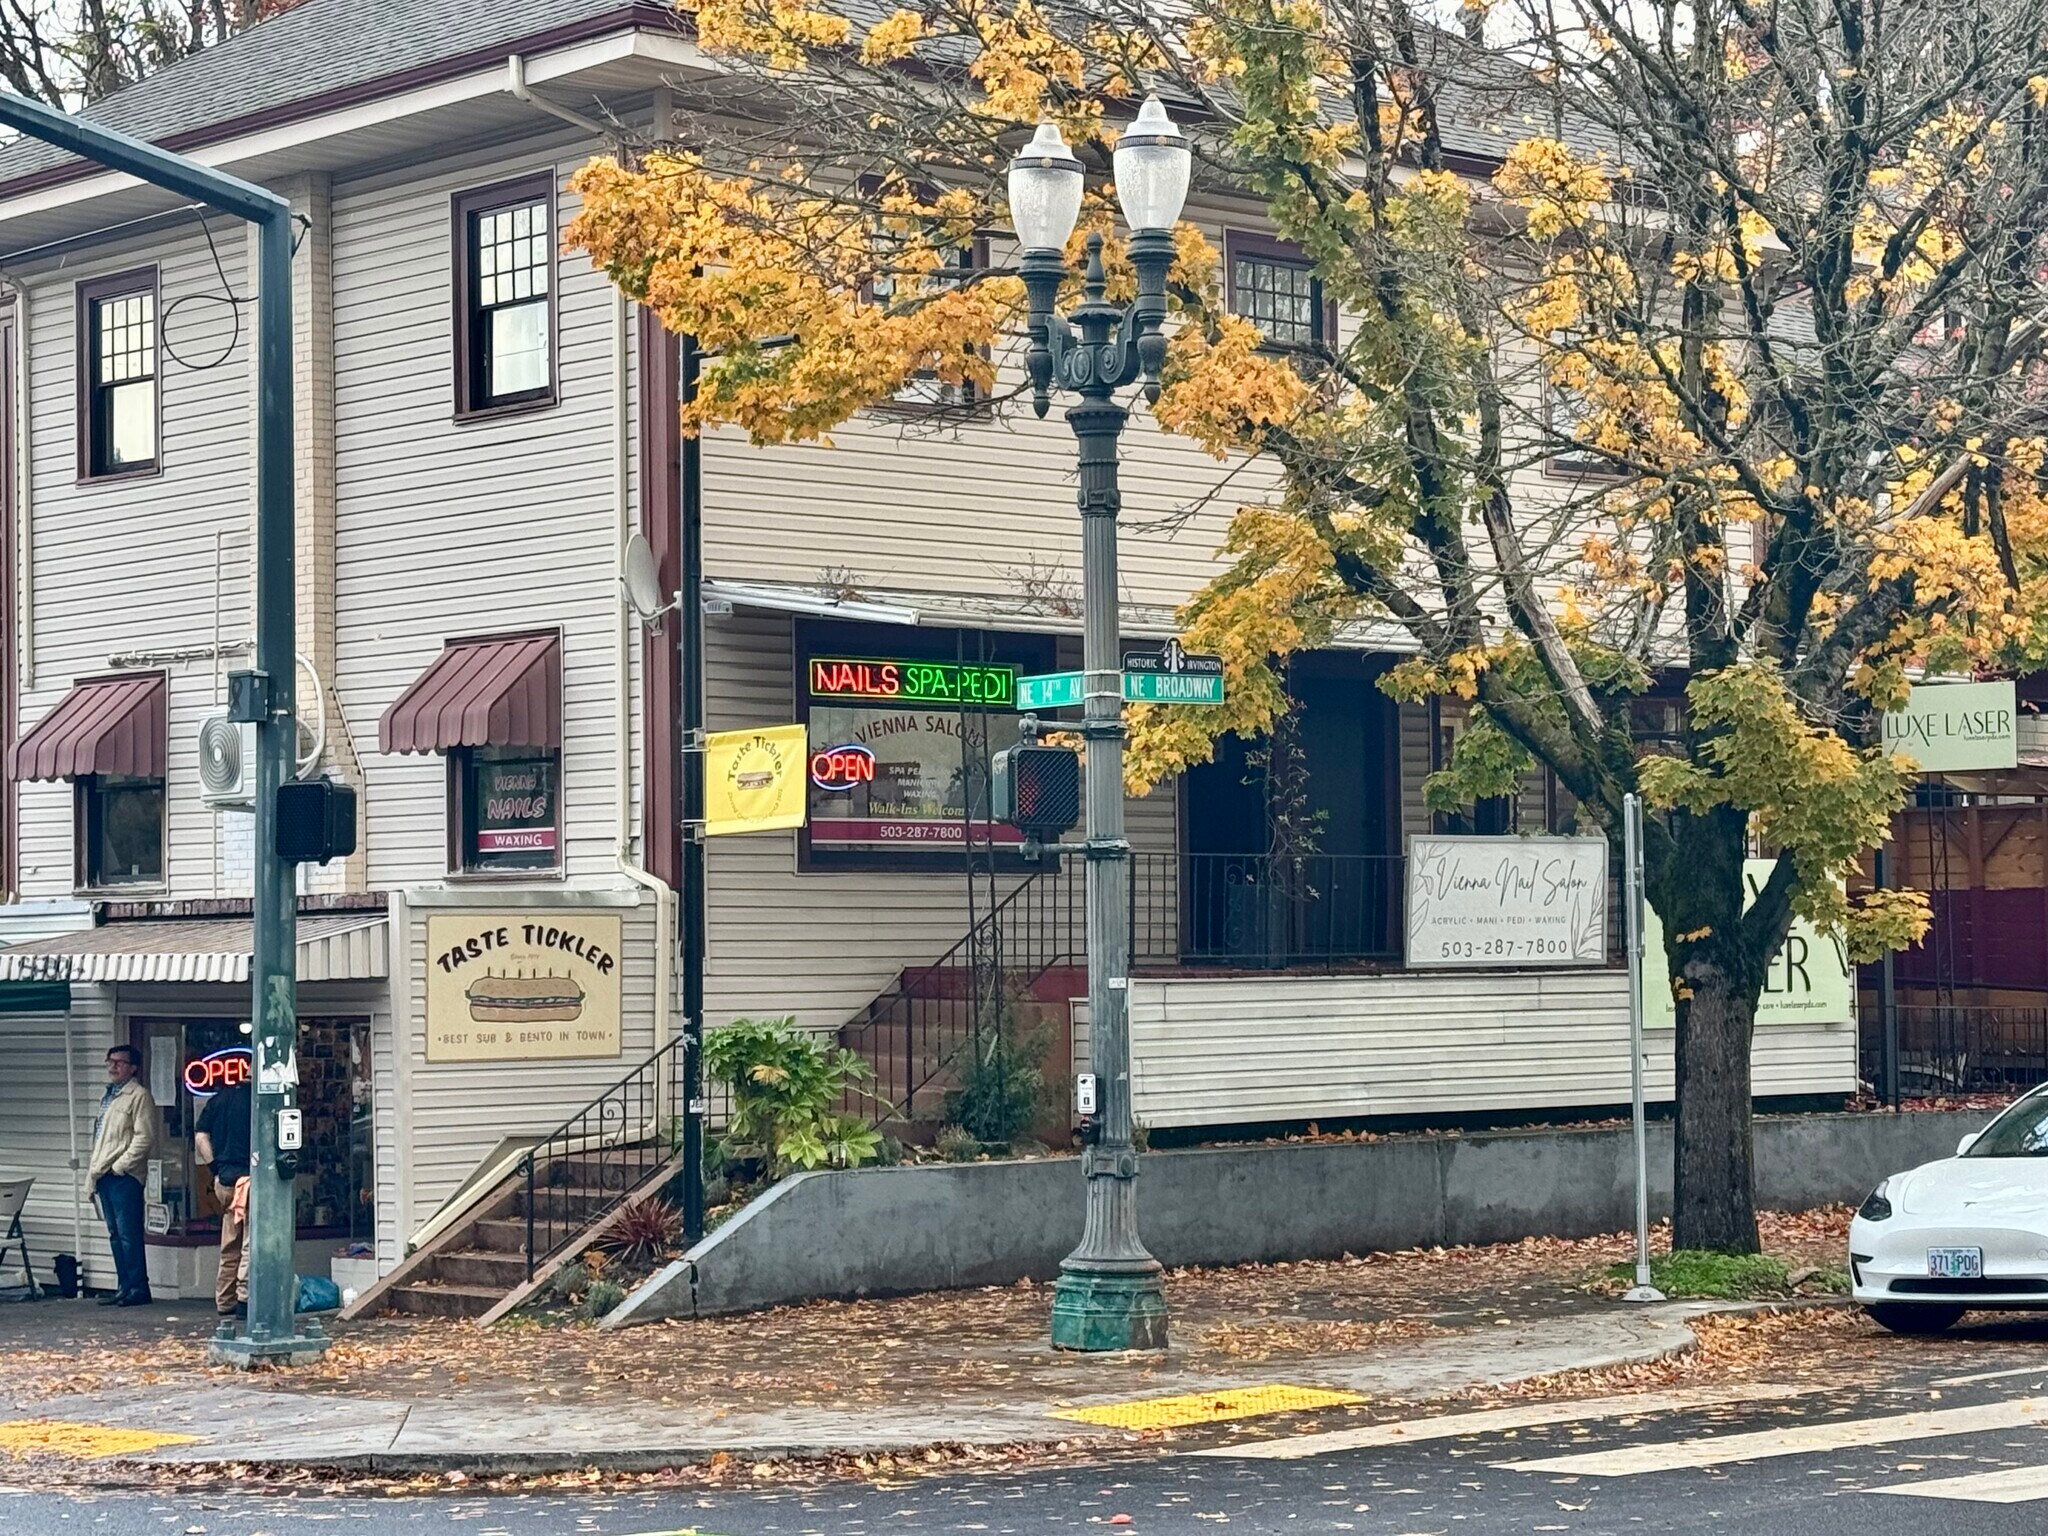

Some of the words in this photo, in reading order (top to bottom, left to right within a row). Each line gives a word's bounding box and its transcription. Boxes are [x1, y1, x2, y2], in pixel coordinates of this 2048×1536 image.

[1127, 658, 1158, 669] HISTORIC
[1187, 660, 1221, 671] IRVINGTON
[816, 663, 900, 695] NAILS
[905, 667, 1006, 699] SPA-PEDI
[1130, 675, 1145, 697] NE
[1155, 676, 1215, 698] BROADWAY
[1020, 683, 1034, 704] NE
[855, 715, 918, 744] VIENNA
[1886, 713, 1938, 748] LUXE
[1945, 710, 2011, 736] LASER
[727, 741, 752, 782] Taste
[753, 735, 783, 778] Tickler
[812, 753, 873, 781] OPEN
[487, 796, 547, 820] NAILS
[868, 801, 918, 816] Walk-Ins
[494, 834, 543, 846] WAXING
[880, 826, 962, 839] 503-287-7800
[1437, 857, 1491, 901] Vienna
[1495, 857, 1540, 907] Nail
[1542, 858, 1588, 906] Salon
[1431, 916, 1467, 925] ACRYLIC
[1476, 916, 1498, 925] MANI
[1506, 916, 1526, 925] PEDI
[1534, 916, 1566, 925] WAXING
[436, 927, 510, 974] TASTE
[521, 924, 615, 976] TICKLER
[1441, 938, 1568, 959] 503-287-7800
[443, 1033, 468, 1044] BEST
[476, 1033, 497, 1043] SUB
[520, 1031, 552, 1043] BENTO
[559, 1031, 569, 1041] IN
[576, 1030, 606, 1041] TOWN
[1930, 1255, 1949, 1270] 371
